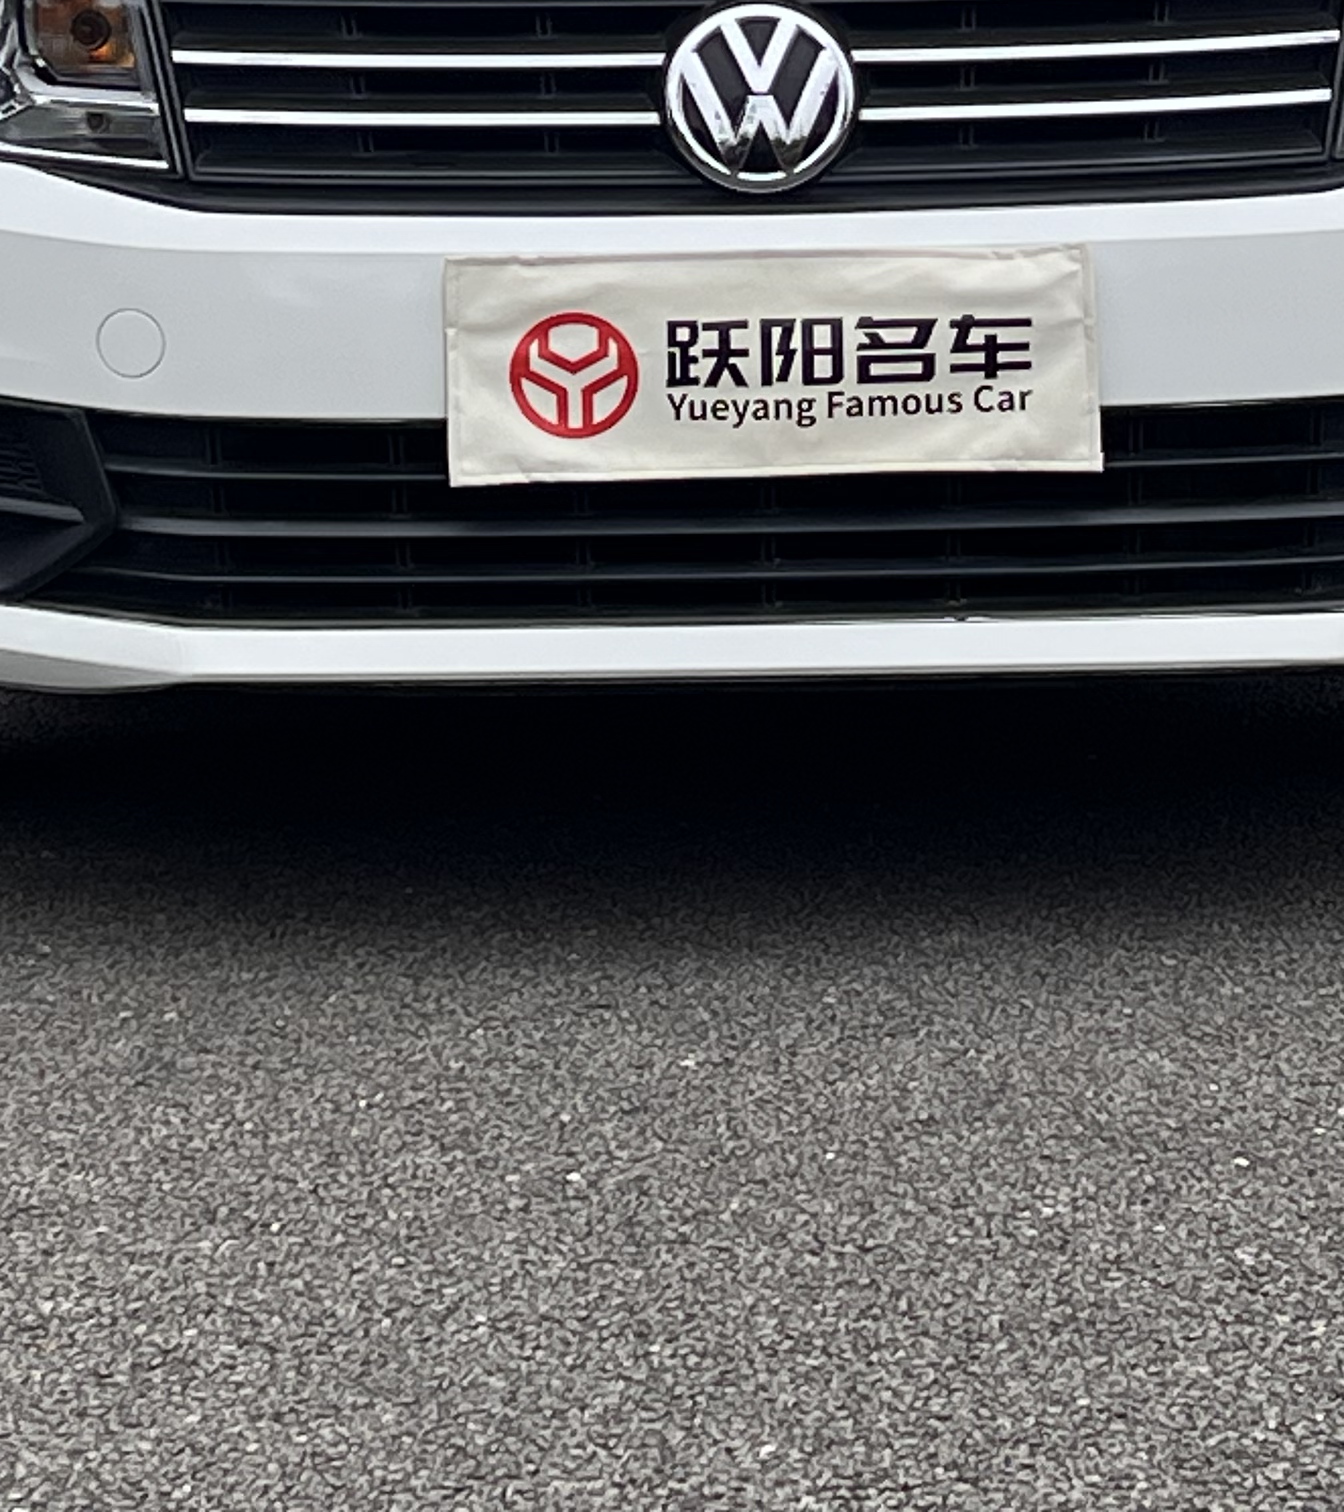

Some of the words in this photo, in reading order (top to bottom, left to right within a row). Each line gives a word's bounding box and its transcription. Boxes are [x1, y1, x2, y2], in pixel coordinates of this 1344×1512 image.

[665, 314, 1034, 390] 跃阳名车
[667, 392, 818, 429] Yueyang
[826, 387, 964, 420] Famous
[973, 384, 1034, 415] Car
